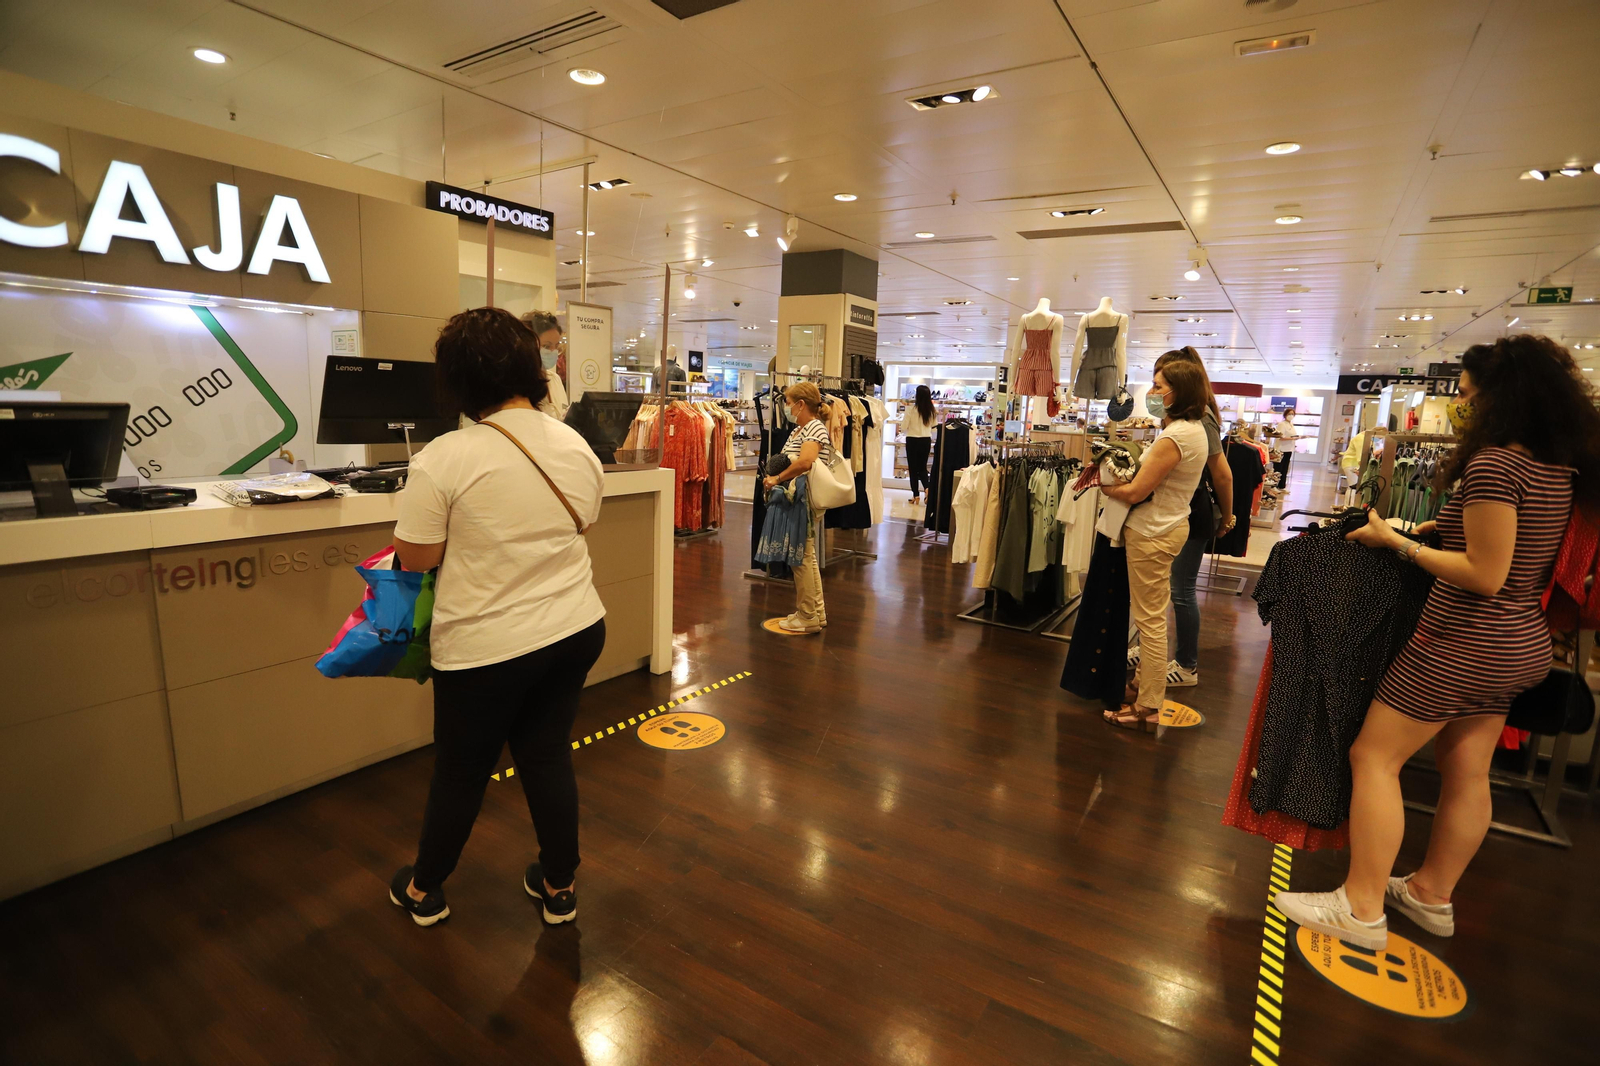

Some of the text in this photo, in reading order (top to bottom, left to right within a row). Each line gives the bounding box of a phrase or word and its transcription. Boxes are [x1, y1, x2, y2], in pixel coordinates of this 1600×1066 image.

[0, 133, 332, 284] CAJA
[440, 190, 550, 232] PROBADORES
[335, 364, 363, 372] Lenovo
[1311, 931, 1320, 953] ESPERE
[1323, 944, 1332, 953] SU
